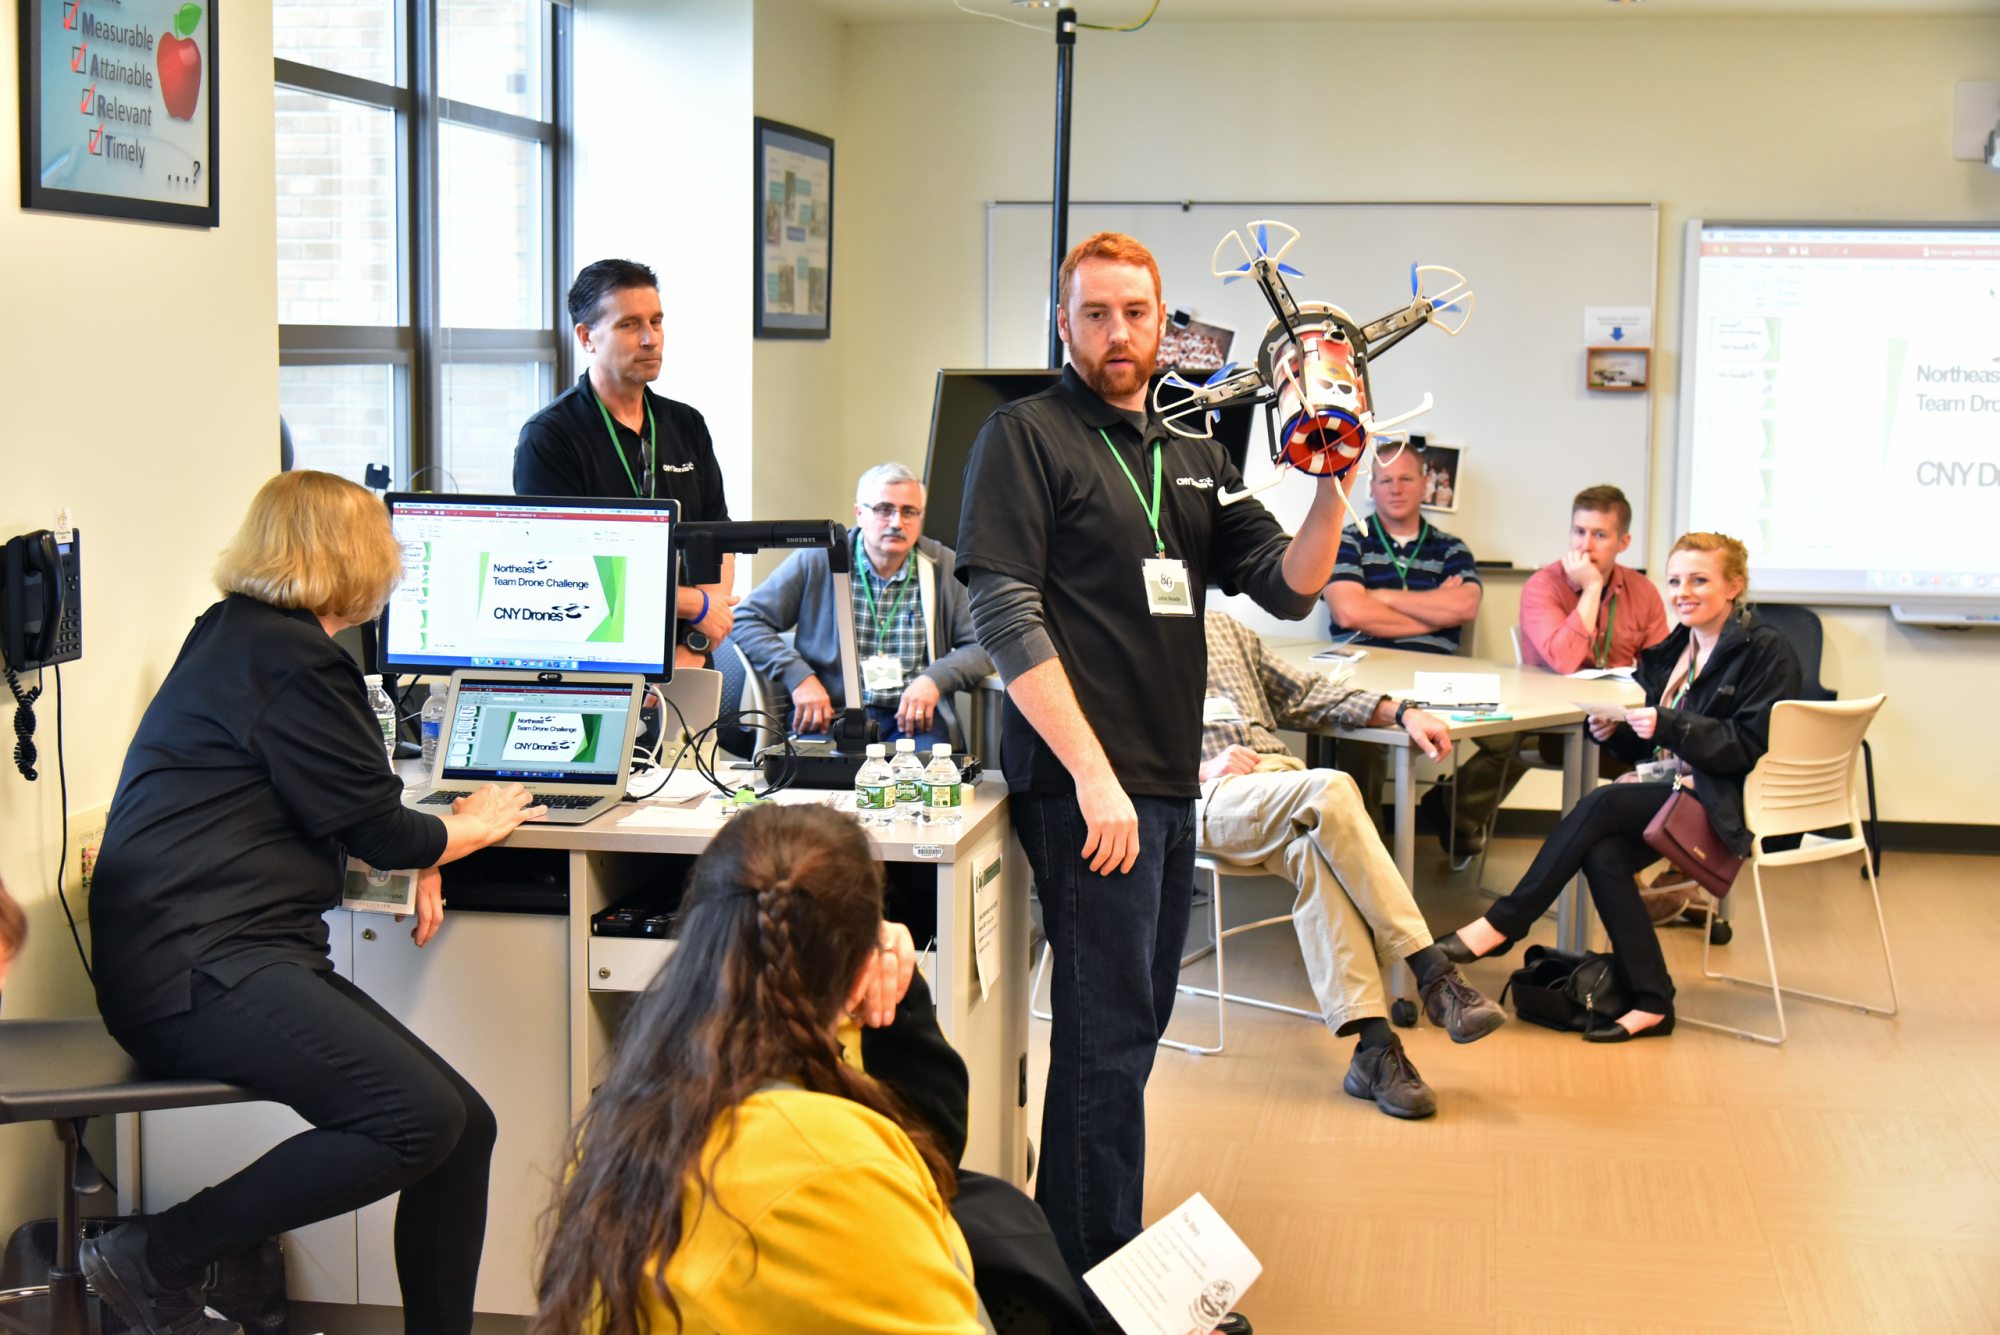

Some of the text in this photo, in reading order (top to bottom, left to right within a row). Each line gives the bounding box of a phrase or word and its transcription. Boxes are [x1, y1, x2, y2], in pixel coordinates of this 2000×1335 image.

[82, 11, 154, 50] Measurable
[90, 54, 153, 88] Attainable
[98, 95, 152, 126] Relevant
[105, 135, 146, 168] Timely
[1915, 393, 1966, 412] Team
[1916, 461, 1975, 486] CNY
[493, 563, 536, 574] Northeast
[493, 576, 590, 591] Team Drone Challenge
[493, 606, 564, 622] CNY Drones
[514, 742, 559, 751] CNY Drones
